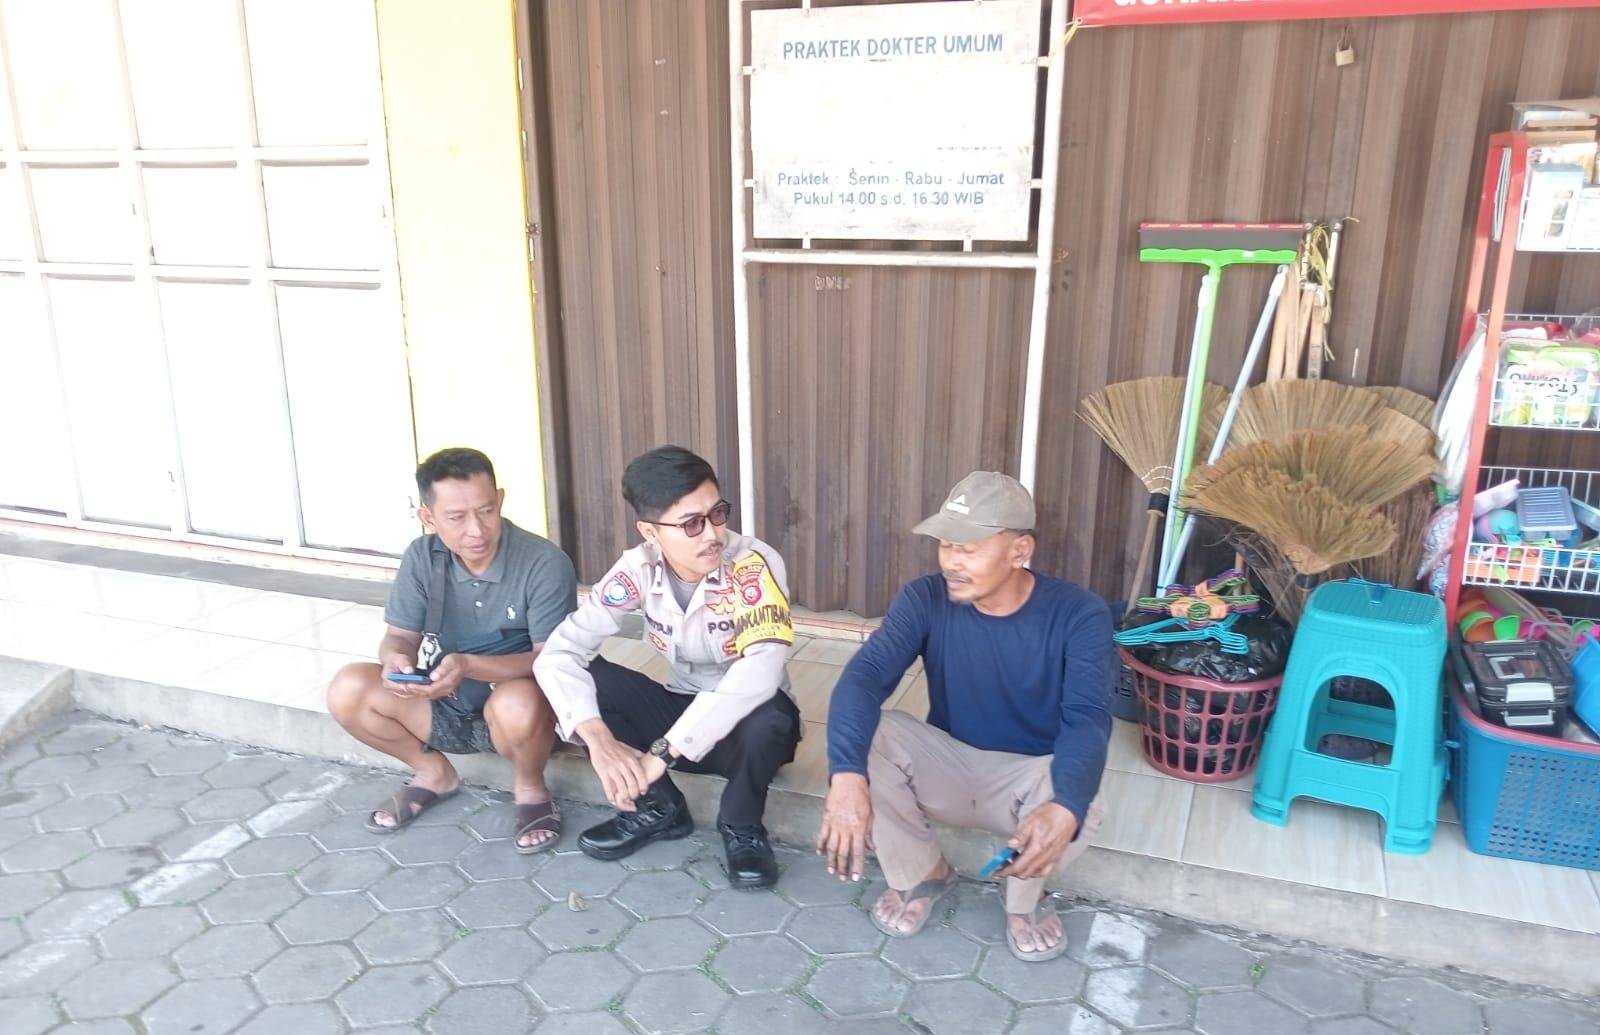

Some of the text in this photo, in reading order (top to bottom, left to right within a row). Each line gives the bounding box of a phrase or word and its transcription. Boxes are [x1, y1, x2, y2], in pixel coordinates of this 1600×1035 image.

[783, 34, 1003, 60] PRAKTEK DOKTER UMUM
[777, 171, 829, 186] Praktek
[848, 170, 890, 185] Senin
[905, 171, 942, 185] Rabu
[957, 171, 1005, 185] Jumat
[794, 191, 833, 205] Pukul
[839, 191, 876, 205] 14.00
[954, 191, 984, 205] WIB
